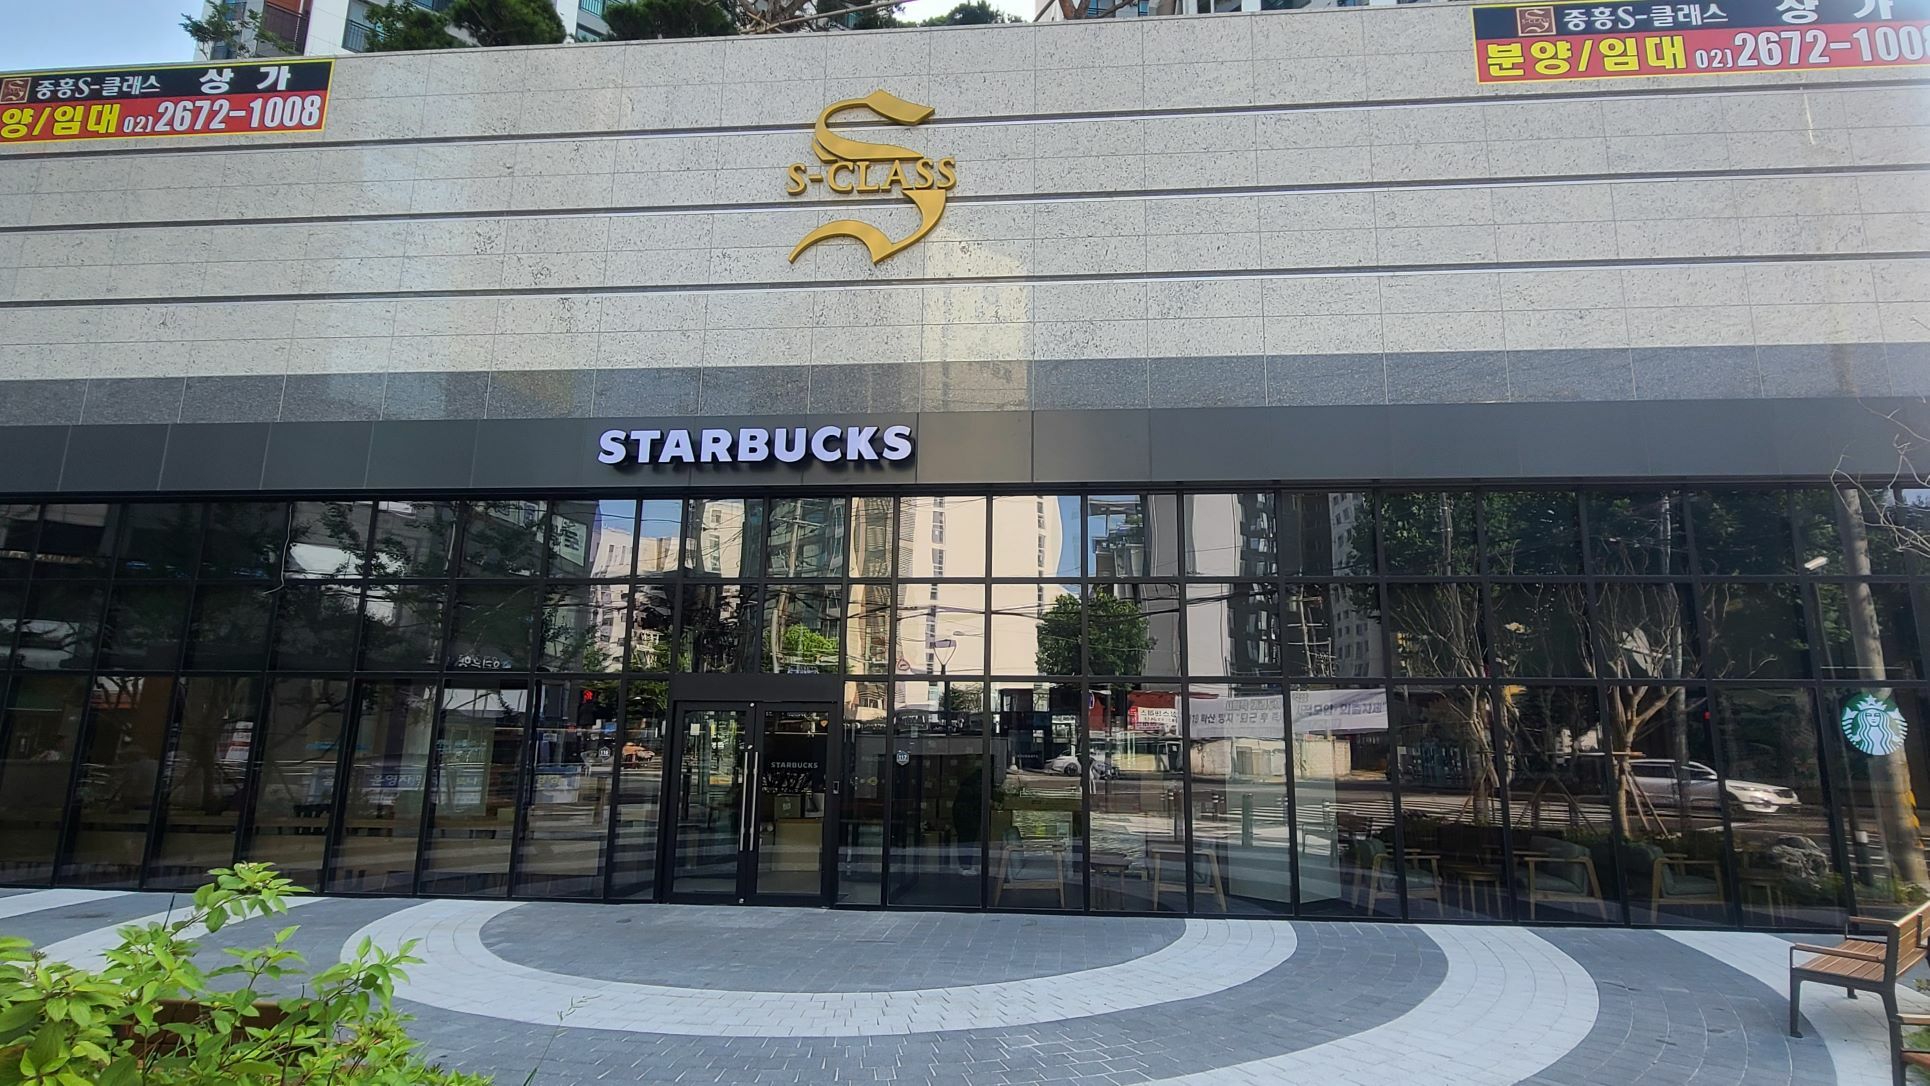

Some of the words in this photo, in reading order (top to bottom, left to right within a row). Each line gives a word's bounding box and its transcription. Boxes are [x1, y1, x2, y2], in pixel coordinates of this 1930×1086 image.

[1563, 4, 1729, 31] 중흥S-클래스
[1487, 35, 1687, 77] 분양/임대
[36, 75, 161, 99] 중흥S-클래스
[787, 156, 957, 196] S-CLASS
[597, 425, 913, 464] STARBUCKS
[771, 761, 818, 769] STARBUCKS
